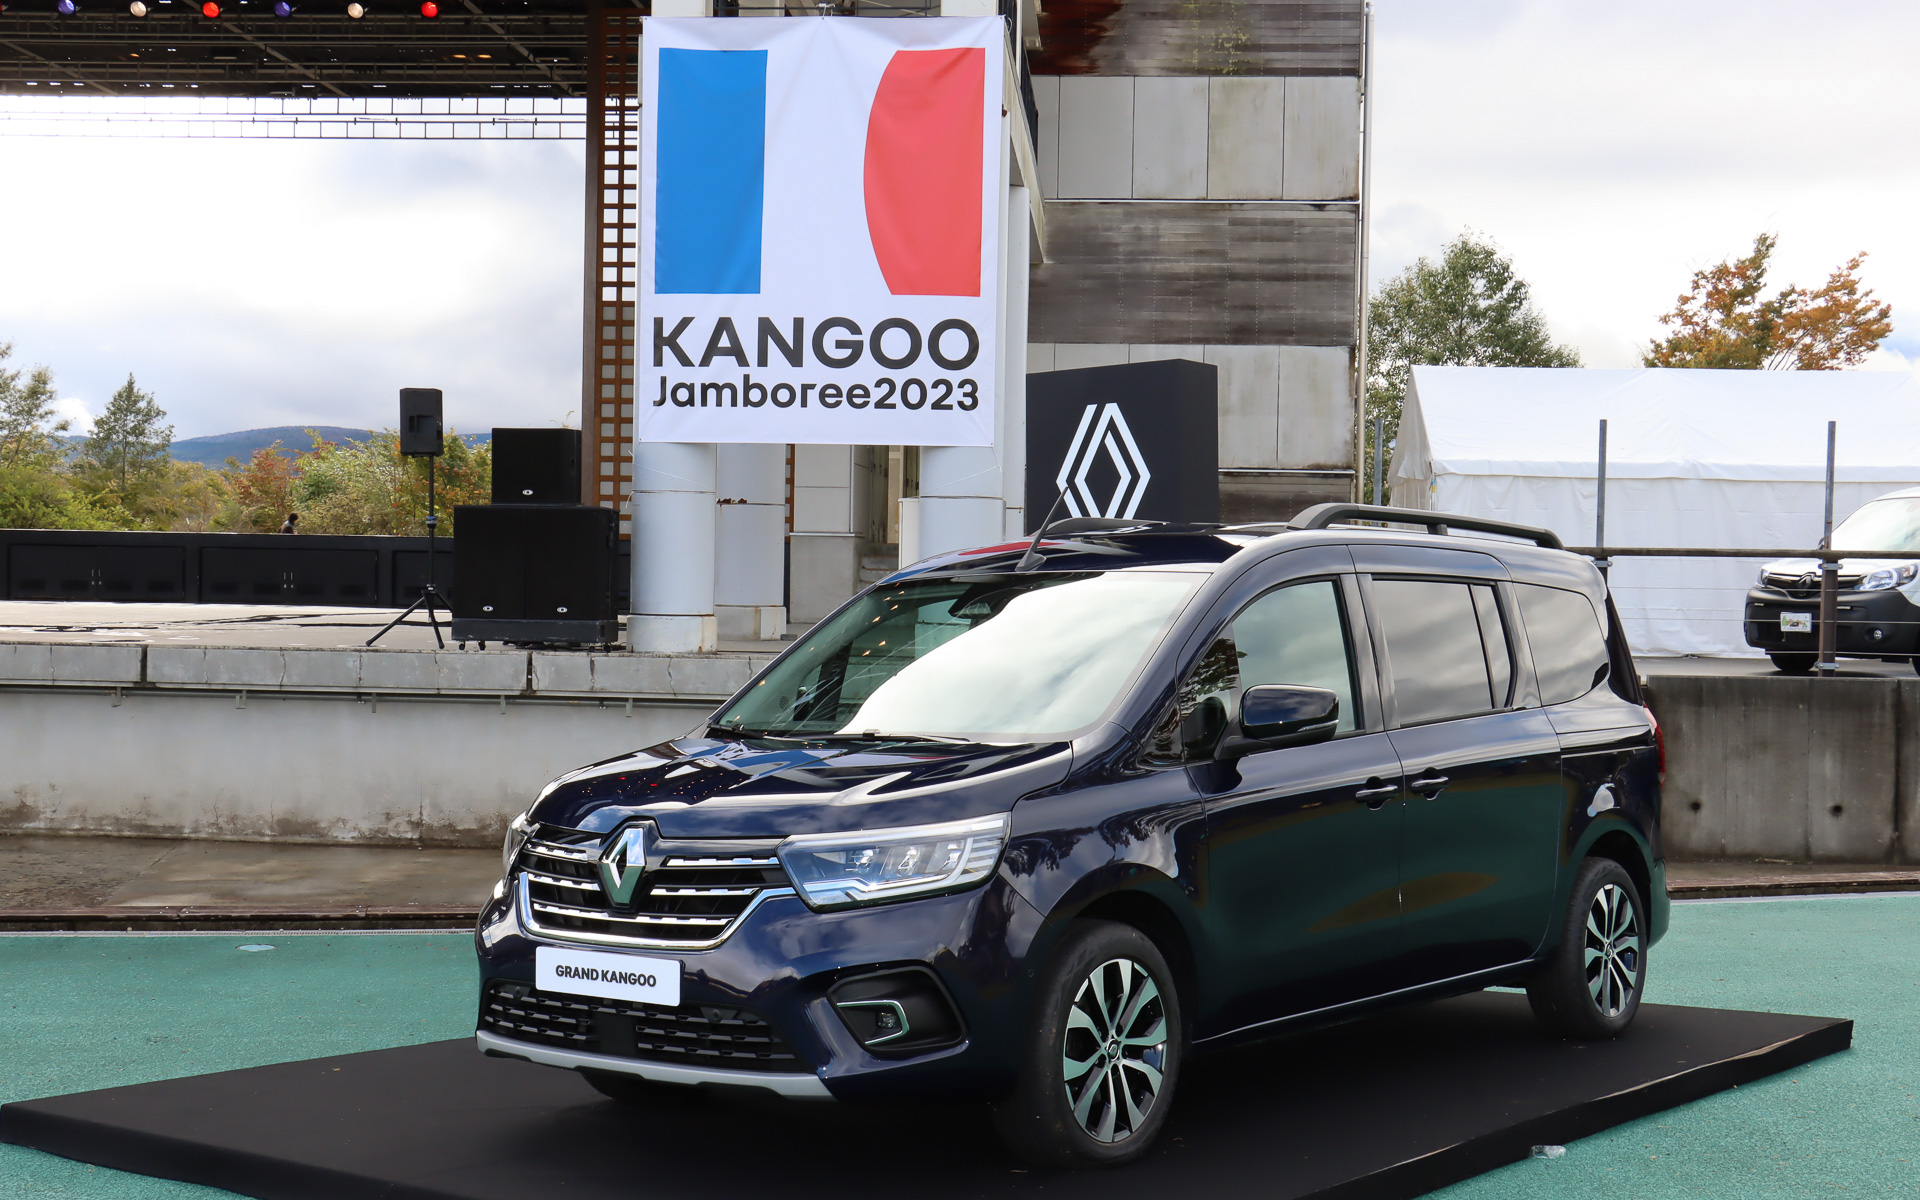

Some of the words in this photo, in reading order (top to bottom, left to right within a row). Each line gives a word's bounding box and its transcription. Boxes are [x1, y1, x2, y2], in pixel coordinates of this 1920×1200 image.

[653, 317, 979, 370] KANGOO
[652, 373, 979, 411] Jamboree2023
[556, 965, 599, 981] GRAND
[602, 970, 656, 987] KANGOO
